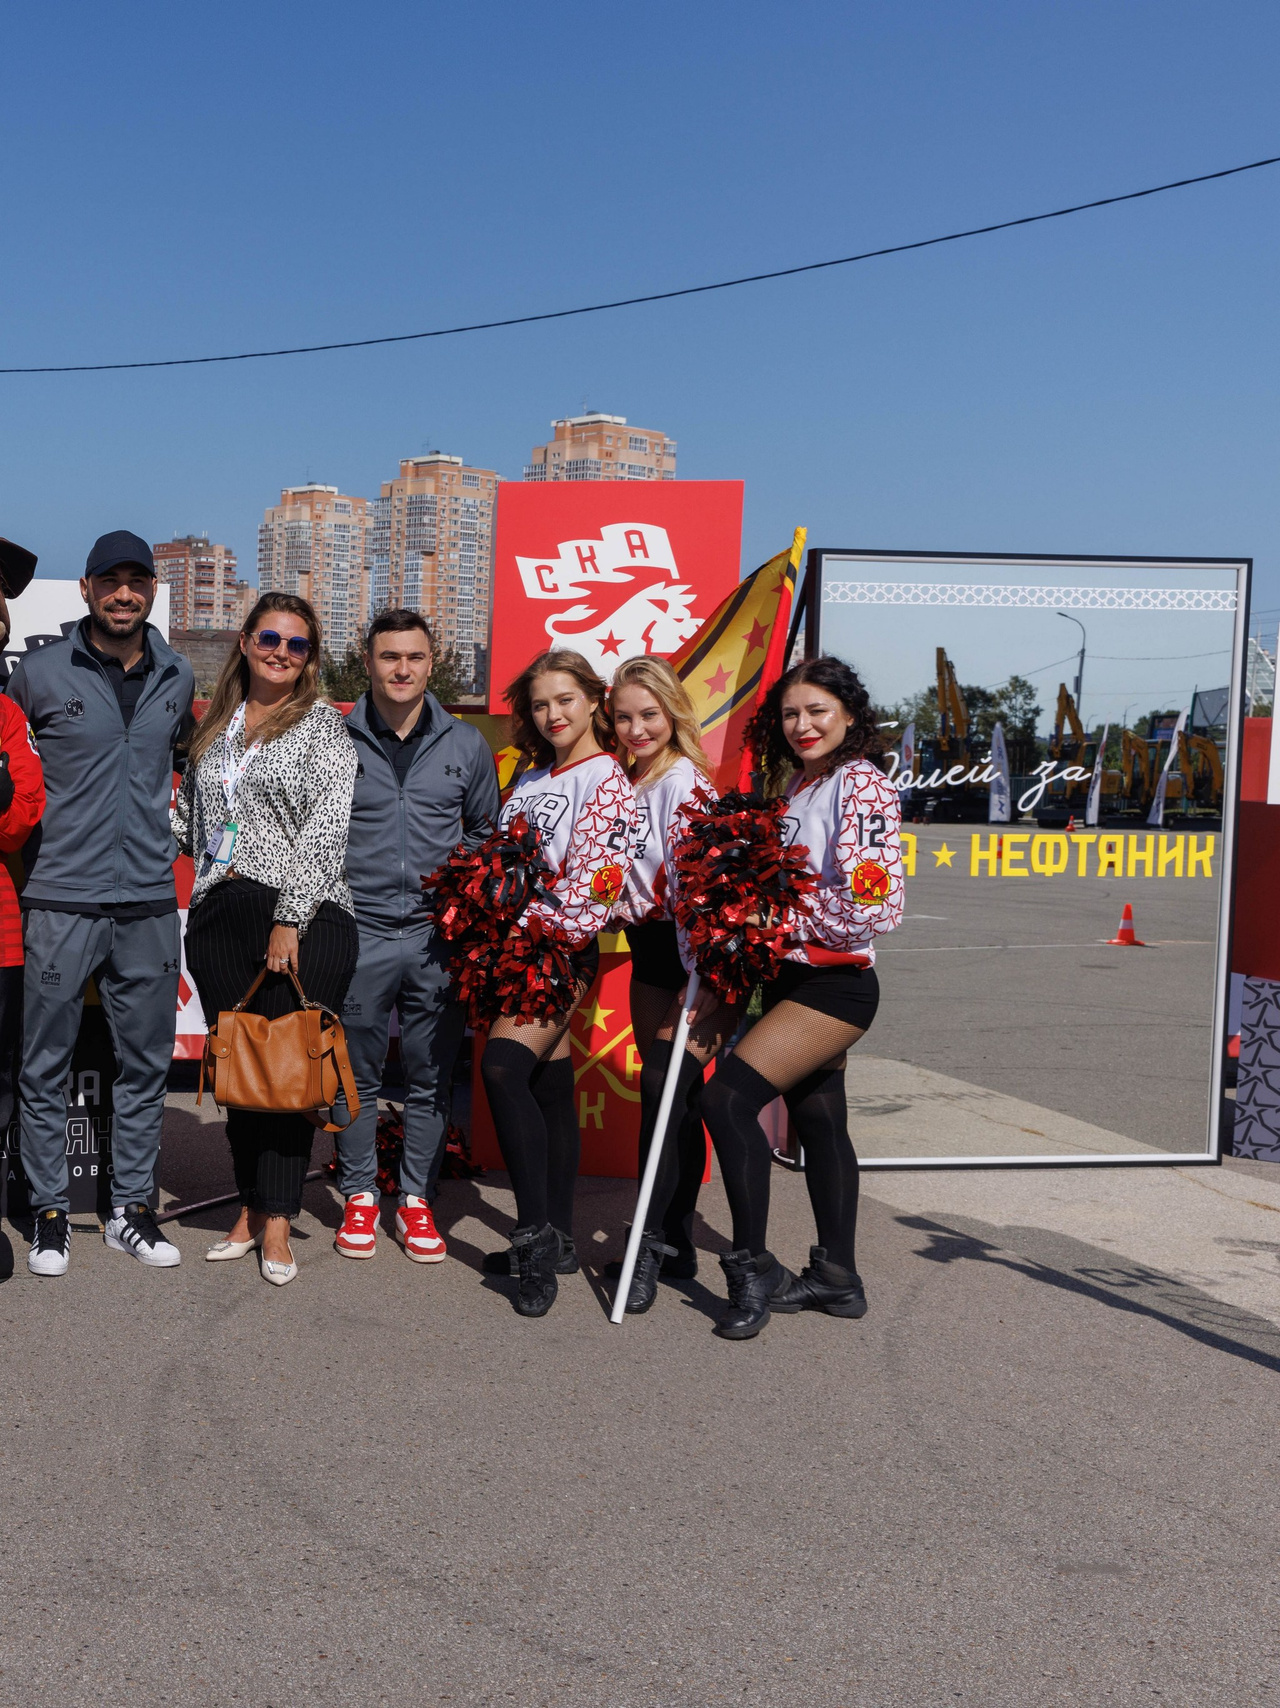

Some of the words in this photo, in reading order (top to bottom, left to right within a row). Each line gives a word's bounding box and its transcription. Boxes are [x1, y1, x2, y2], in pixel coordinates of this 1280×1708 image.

[535, 529, 650, 593] СКА
[1017, 760, 1092, 812] за
[856, 813, 886, 848] 12
[970, 833, 1216, 878] НЕФТЯНИК
[601, 870, 617, 900] СКА
[857, 869, 882, 897] СКА
